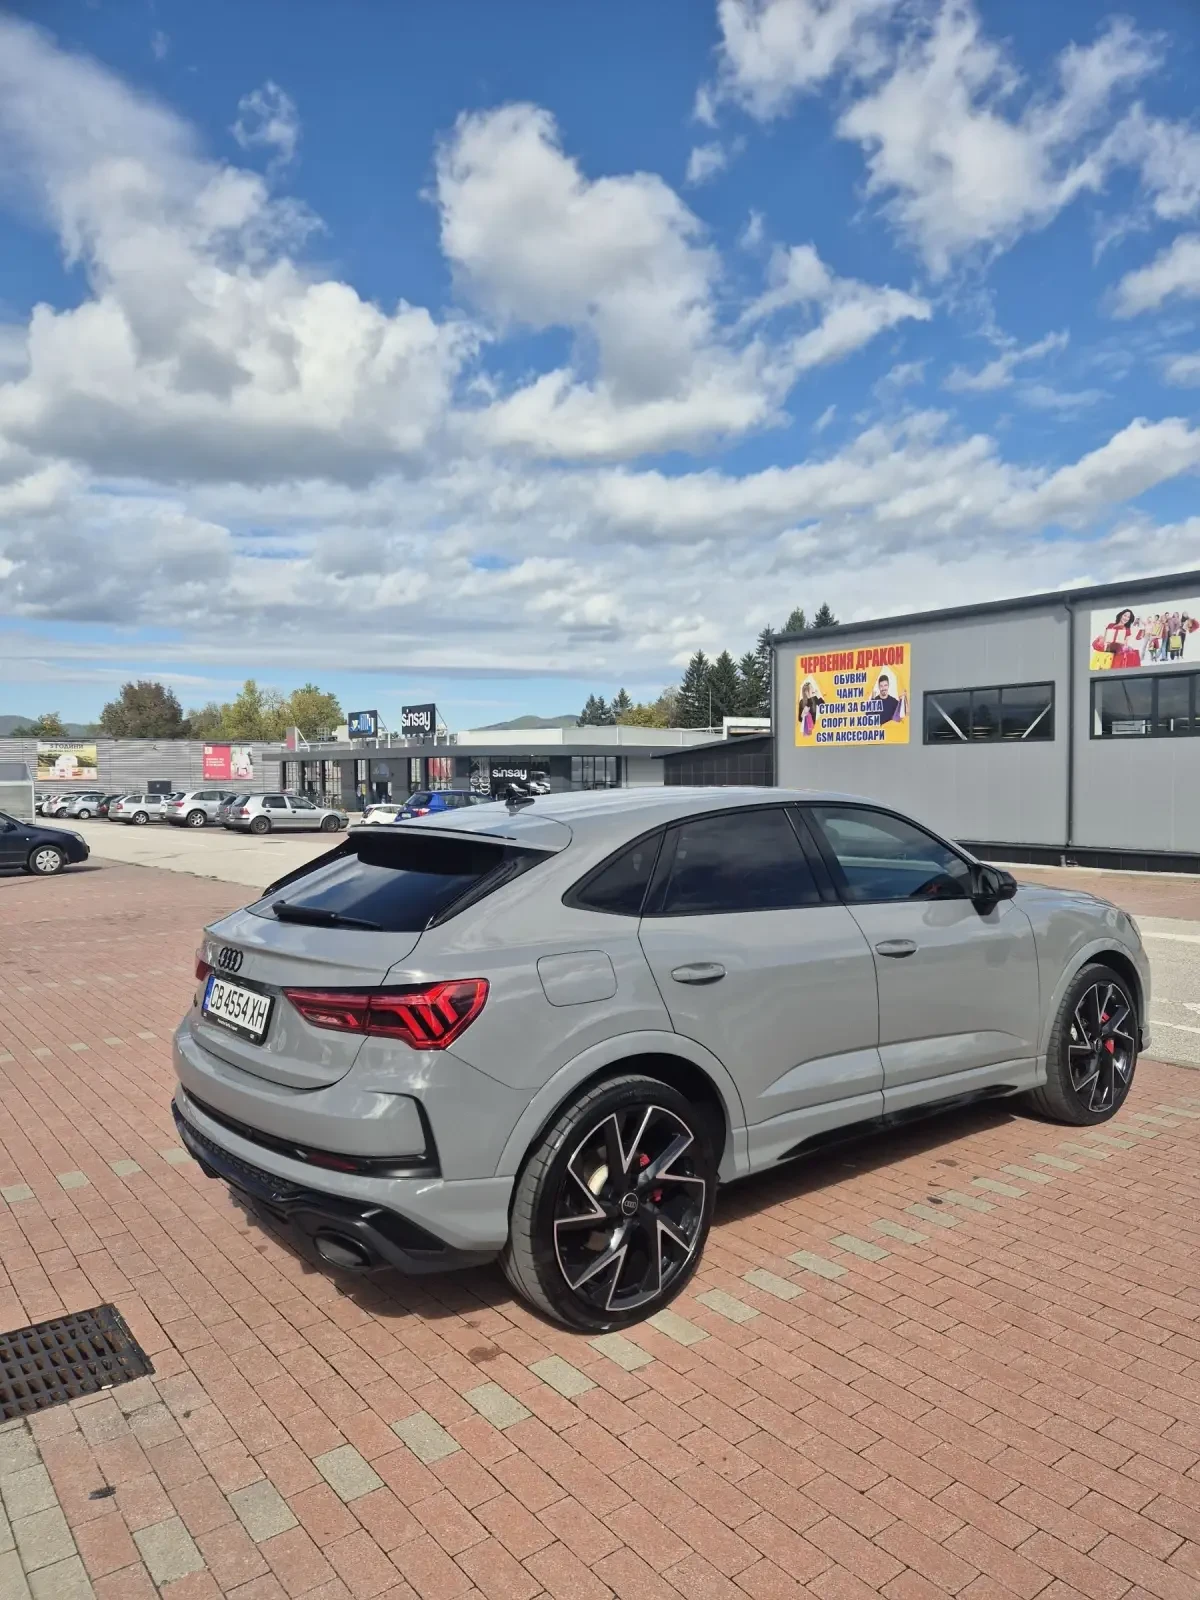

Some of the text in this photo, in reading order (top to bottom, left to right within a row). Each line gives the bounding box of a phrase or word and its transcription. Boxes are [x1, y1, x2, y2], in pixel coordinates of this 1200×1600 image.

[801, 646, 904, 674] ЧЕРВЕНИЯ ДРАКОН
[834, 672, 867, 685] ОБУВКИ
[836, 687, 864, 699] ЧАНТИ
[819, 700, 883, 714] СТОКИ ЗА БИТА
[402, 709, 430, 731] sinsay
[821, 715, 880, 728] СПОРТ И ХОБИ
[816, 730, 885, 743] GSM АКСЕСОАРИ
[492, 767, 527, 780] sinsay
